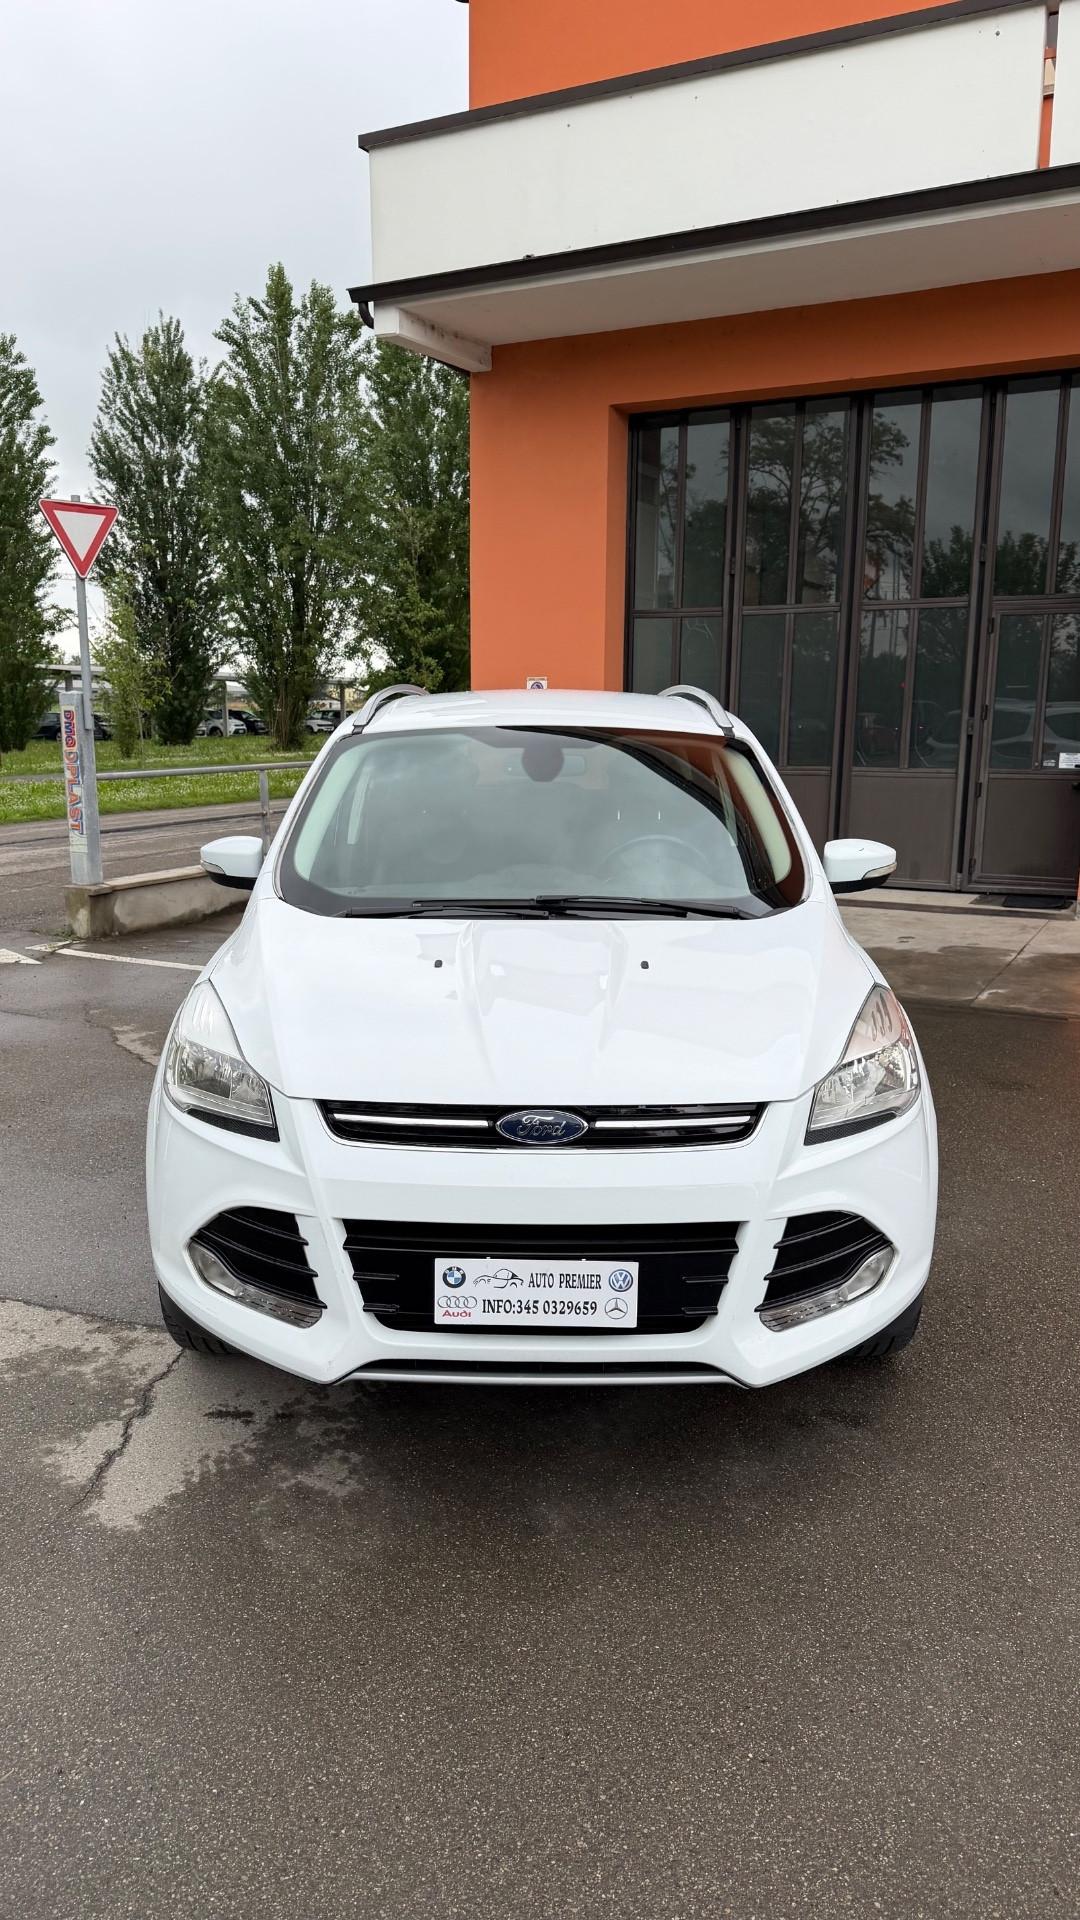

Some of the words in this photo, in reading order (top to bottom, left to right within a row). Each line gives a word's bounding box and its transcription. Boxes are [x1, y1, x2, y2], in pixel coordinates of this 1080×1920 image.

[517, 1115, 566, 1136] Ford
[528, 1273, 554, 1288] AUTO
[559, 1273, 602, 1290] PREMIER
[442, 1309, 471, 1317] Audi
[482, 1299, 539, 1314] INFO:345
[543, 1300, 597, 1315] 0329659
